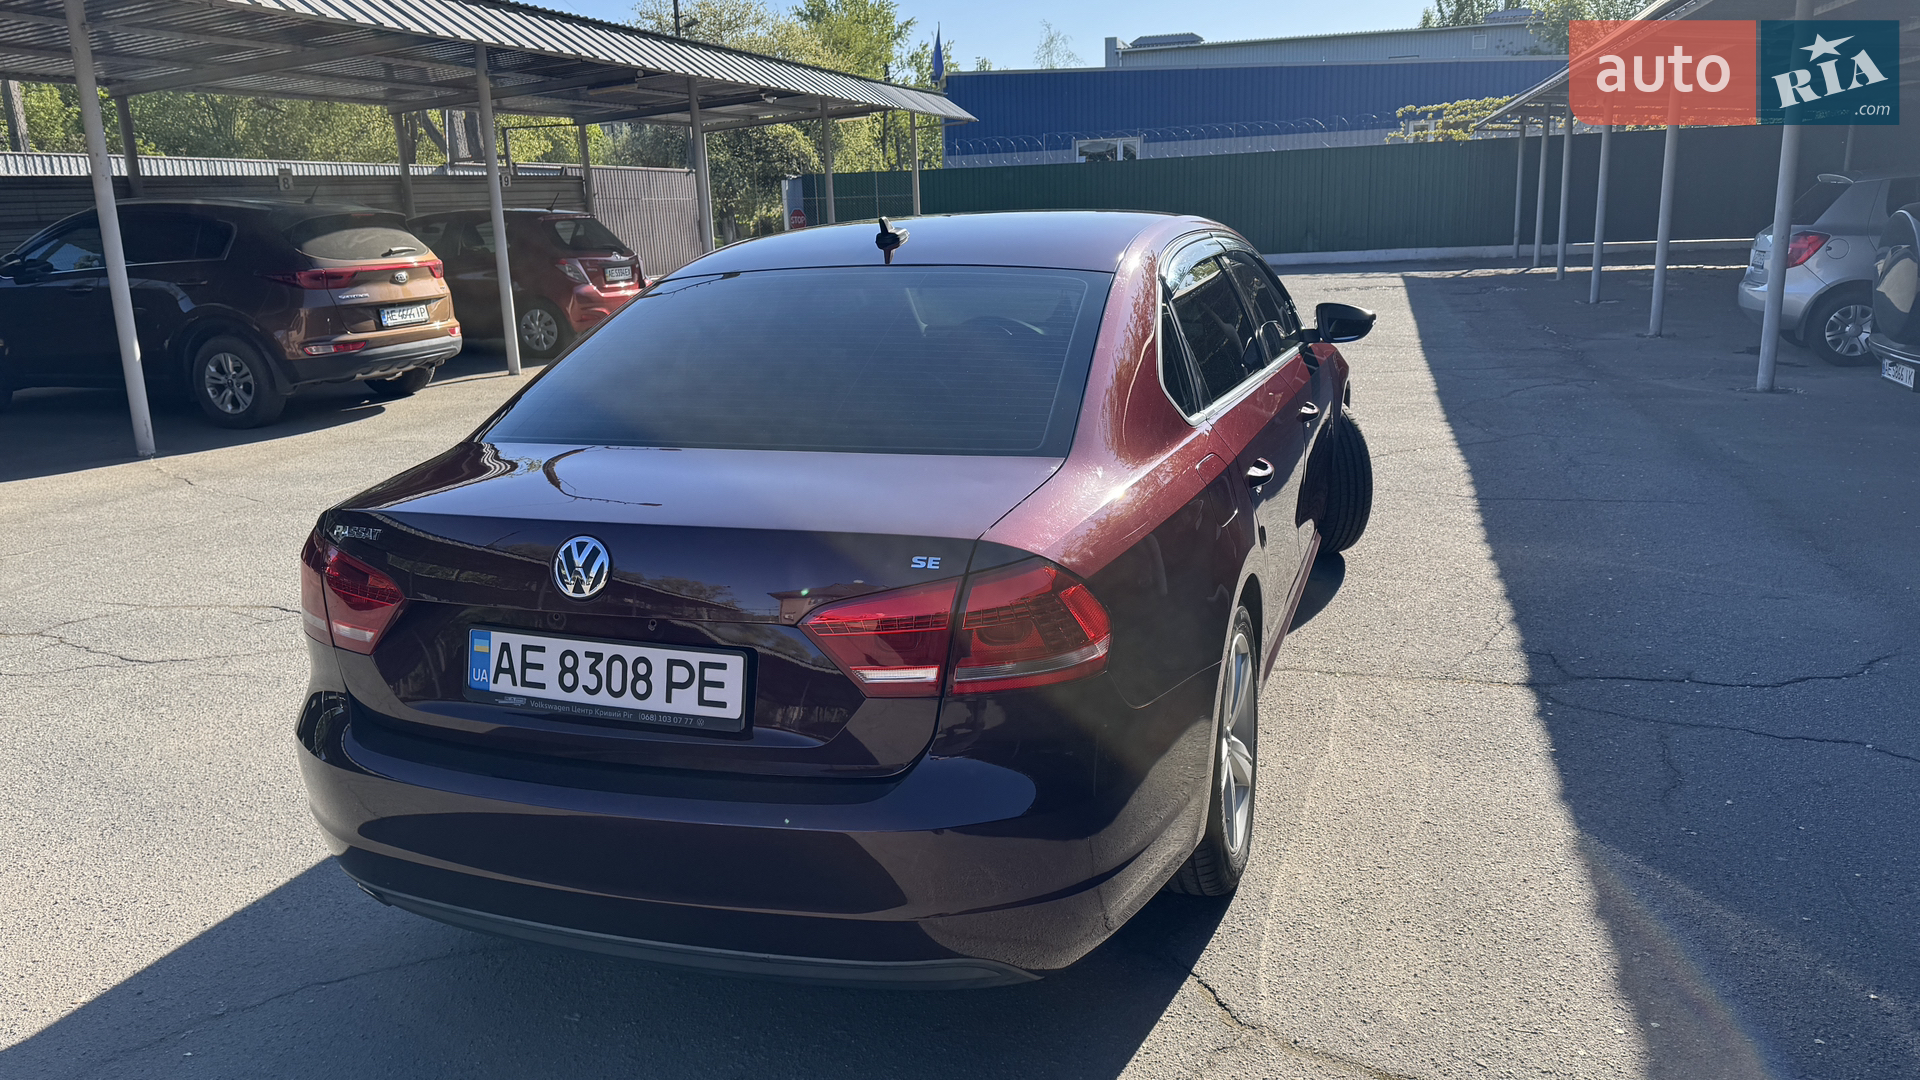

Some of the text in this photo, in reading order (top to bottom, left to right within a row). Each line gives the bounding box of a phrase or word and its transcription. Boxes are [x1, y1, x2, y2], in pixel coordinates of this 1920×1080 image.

[282, 177, 290, 190] 8
[503, 175, 510, 187] 9
[790, 215, 807, 224] STOP
[386, 309, 398, 321] AE
[333, 524, 382, 541] PASSAT
[911, 555, 942, 570] SE
[472, 667, 489, 683] UA
[492, 642, 728, 709] AE 8308 PE
[529, 700, 571, 712] Volkswagen
[571, 706, 593, 716] Центр
[594, 708, 621, 718] Кривий
[638, 712, 657, 721] (068)
[658, 714, 672, 723] 103
[672, 715, 682, 724] 07
[684, 717, 694, 725] 77
